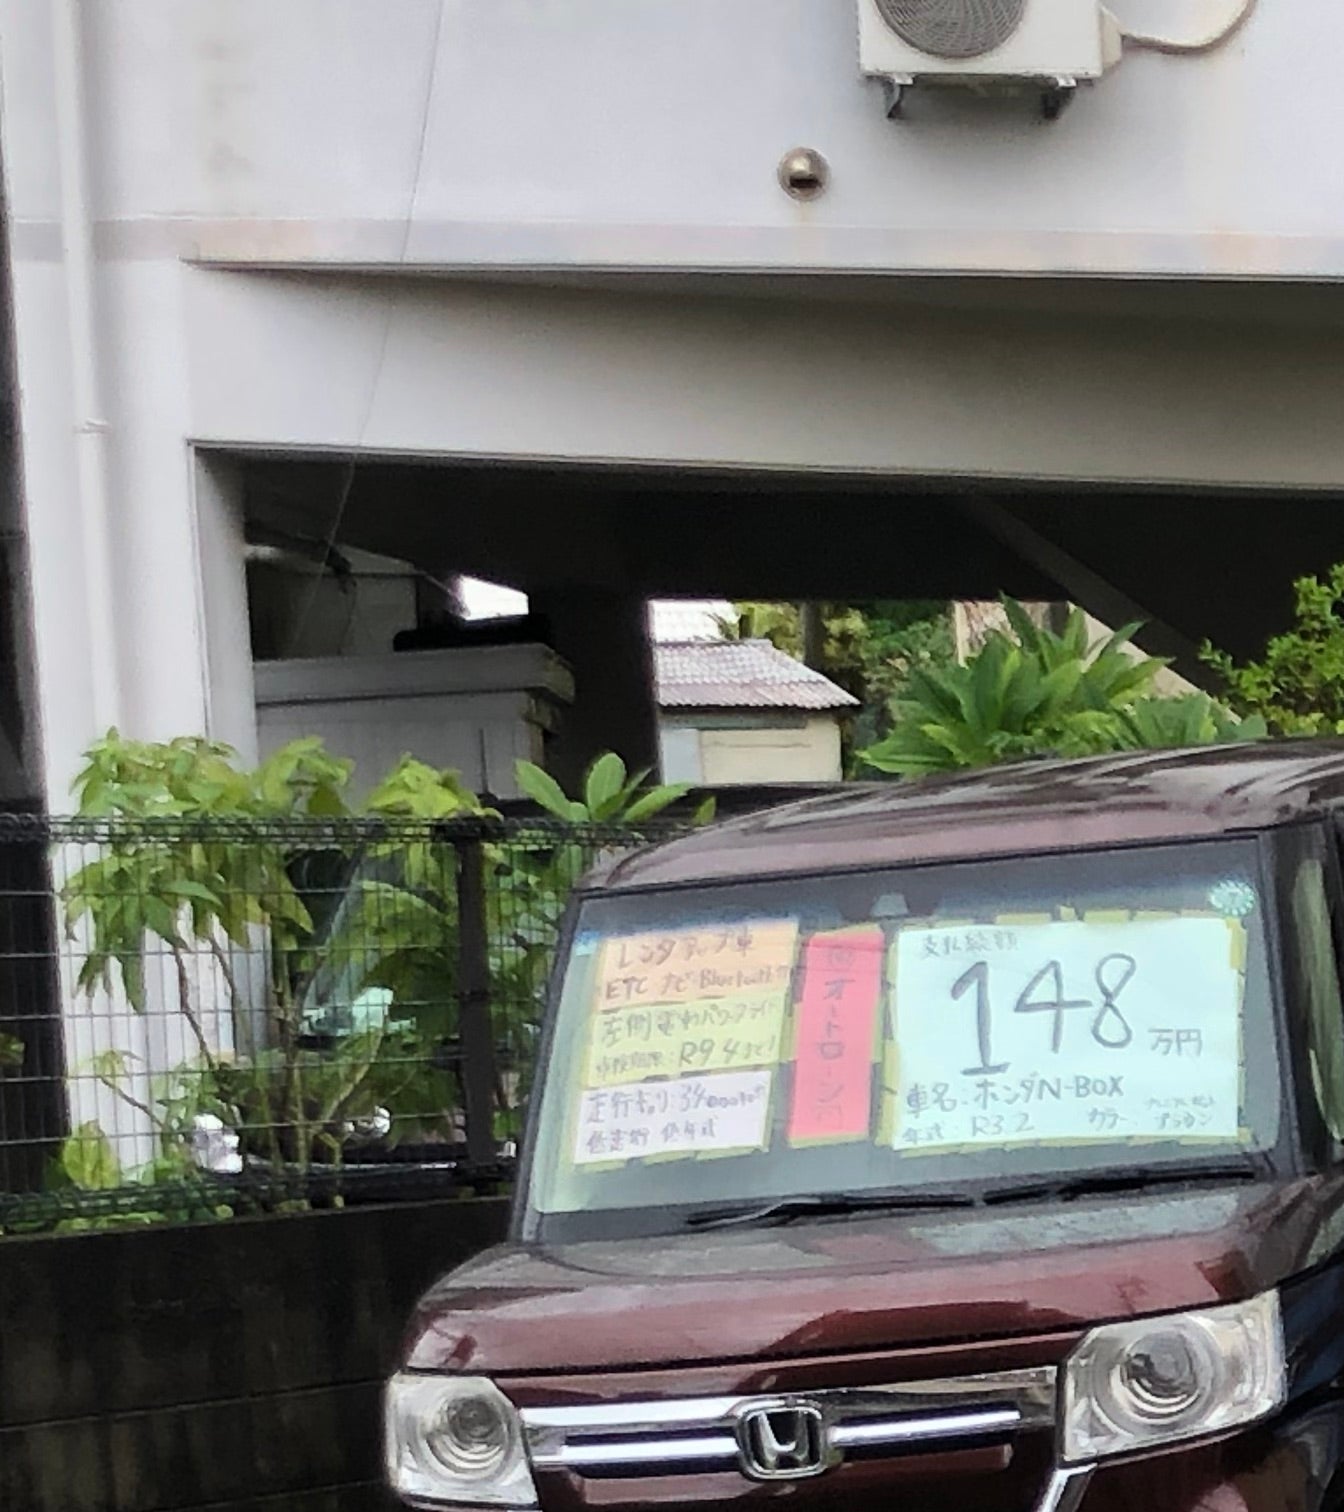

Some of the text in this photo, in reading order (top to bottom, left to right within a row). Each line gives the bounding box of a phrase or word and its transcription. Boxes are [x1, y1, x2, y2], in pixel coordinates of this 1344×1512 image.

[605, 975, 649, 1001] ETC
[950, 953, 1204, 1077] 148 万円
